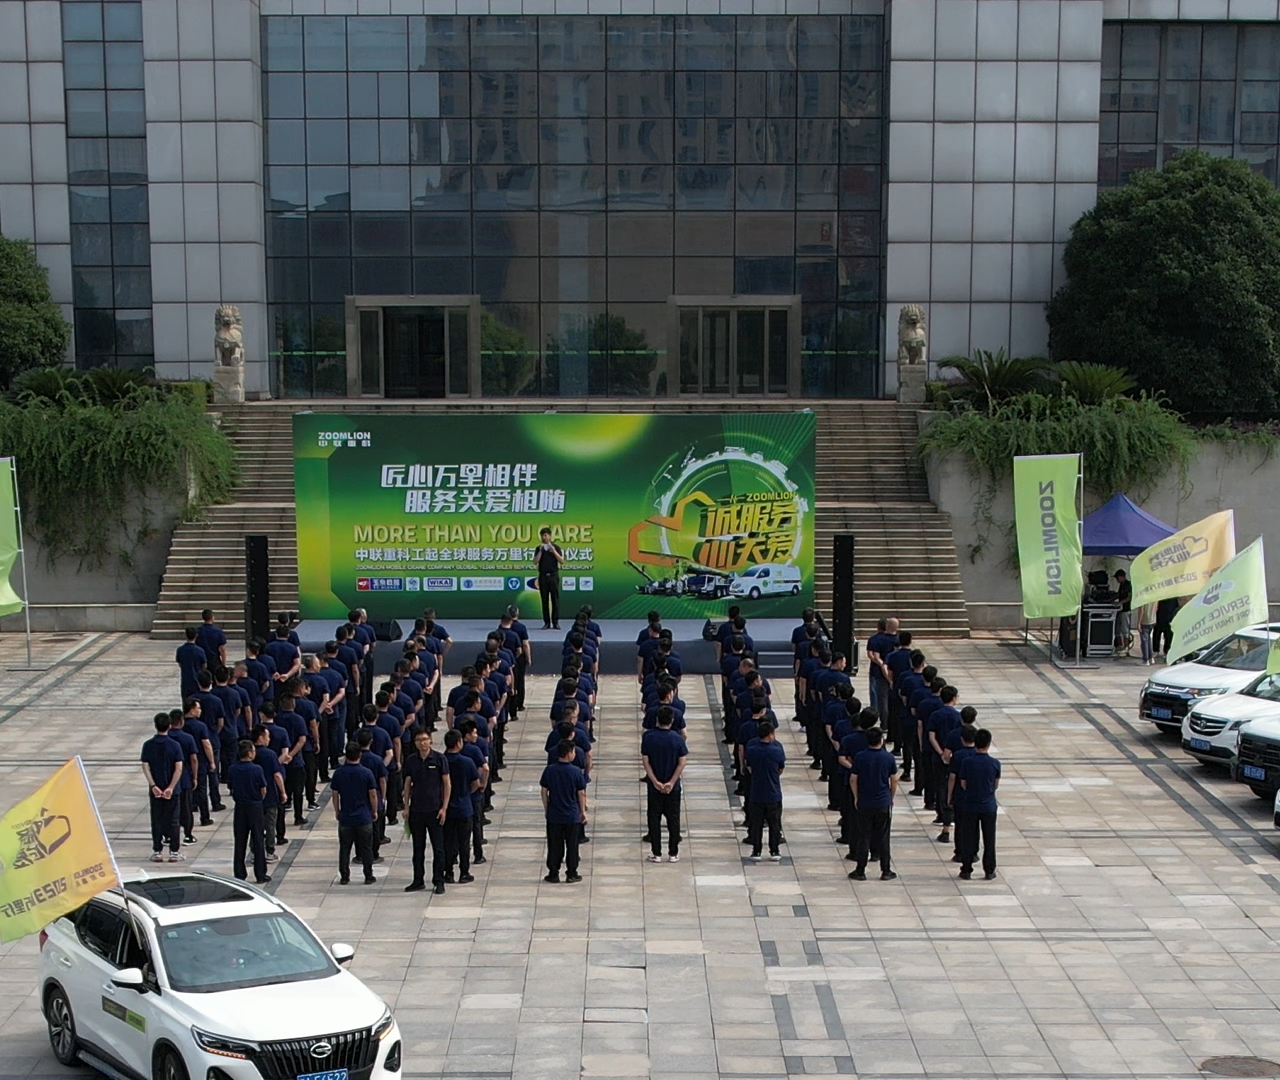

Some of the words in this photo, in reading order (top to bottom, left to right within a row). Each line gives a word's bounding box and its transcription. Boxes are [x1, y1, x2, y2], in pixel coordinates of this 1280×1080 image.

[318, 432, 371, 440] ZOOMLION
[381, 464, 538, 487] 匠心万里相伴
[405, 490, 566, 513] 服务关爱相随
[746, 492, 796, 501] ZOOMLION
[353, 525, 417, 543] MORE
[422, 525, 482, 543] THAN
[488, 525, 532, 543] YOU
